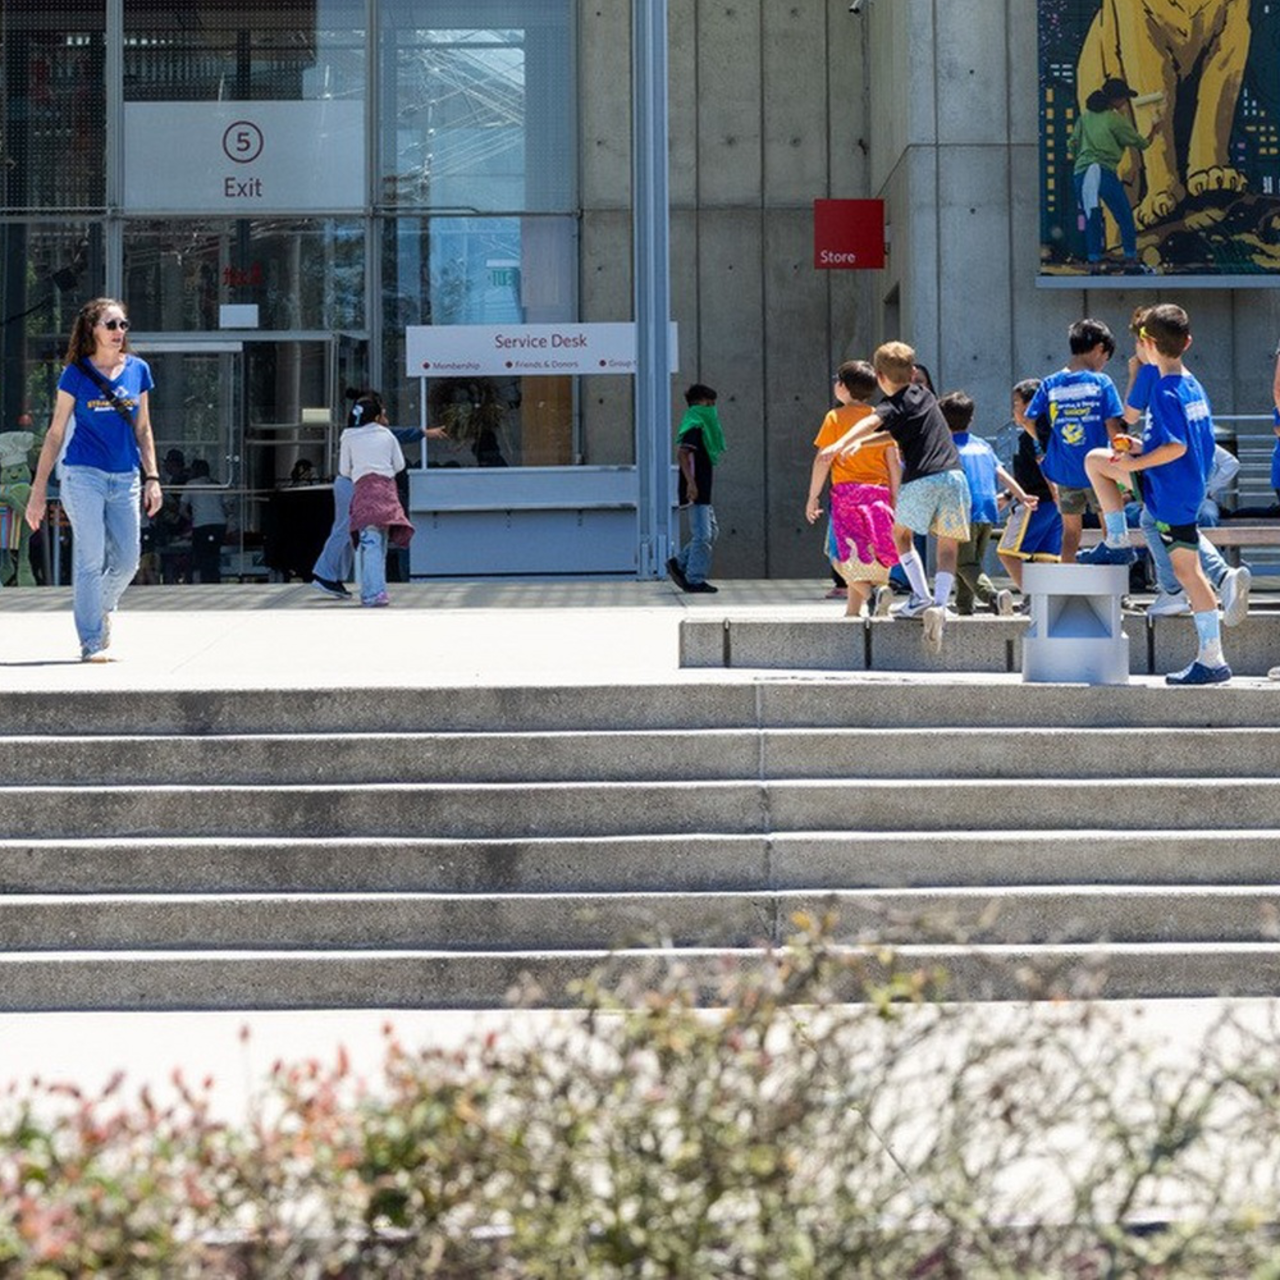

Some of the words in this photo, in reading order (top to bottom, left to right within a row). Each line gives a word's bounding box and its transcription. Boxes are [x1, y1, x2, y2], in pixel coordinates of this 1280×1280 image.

[224, 176, 262, 197] Exit
[820, 249, 856, 264] Store
[494, 333, 547, 349] Service
[551, 333, 588, 348] Desk
[552, 360, 579, 368] Donors
